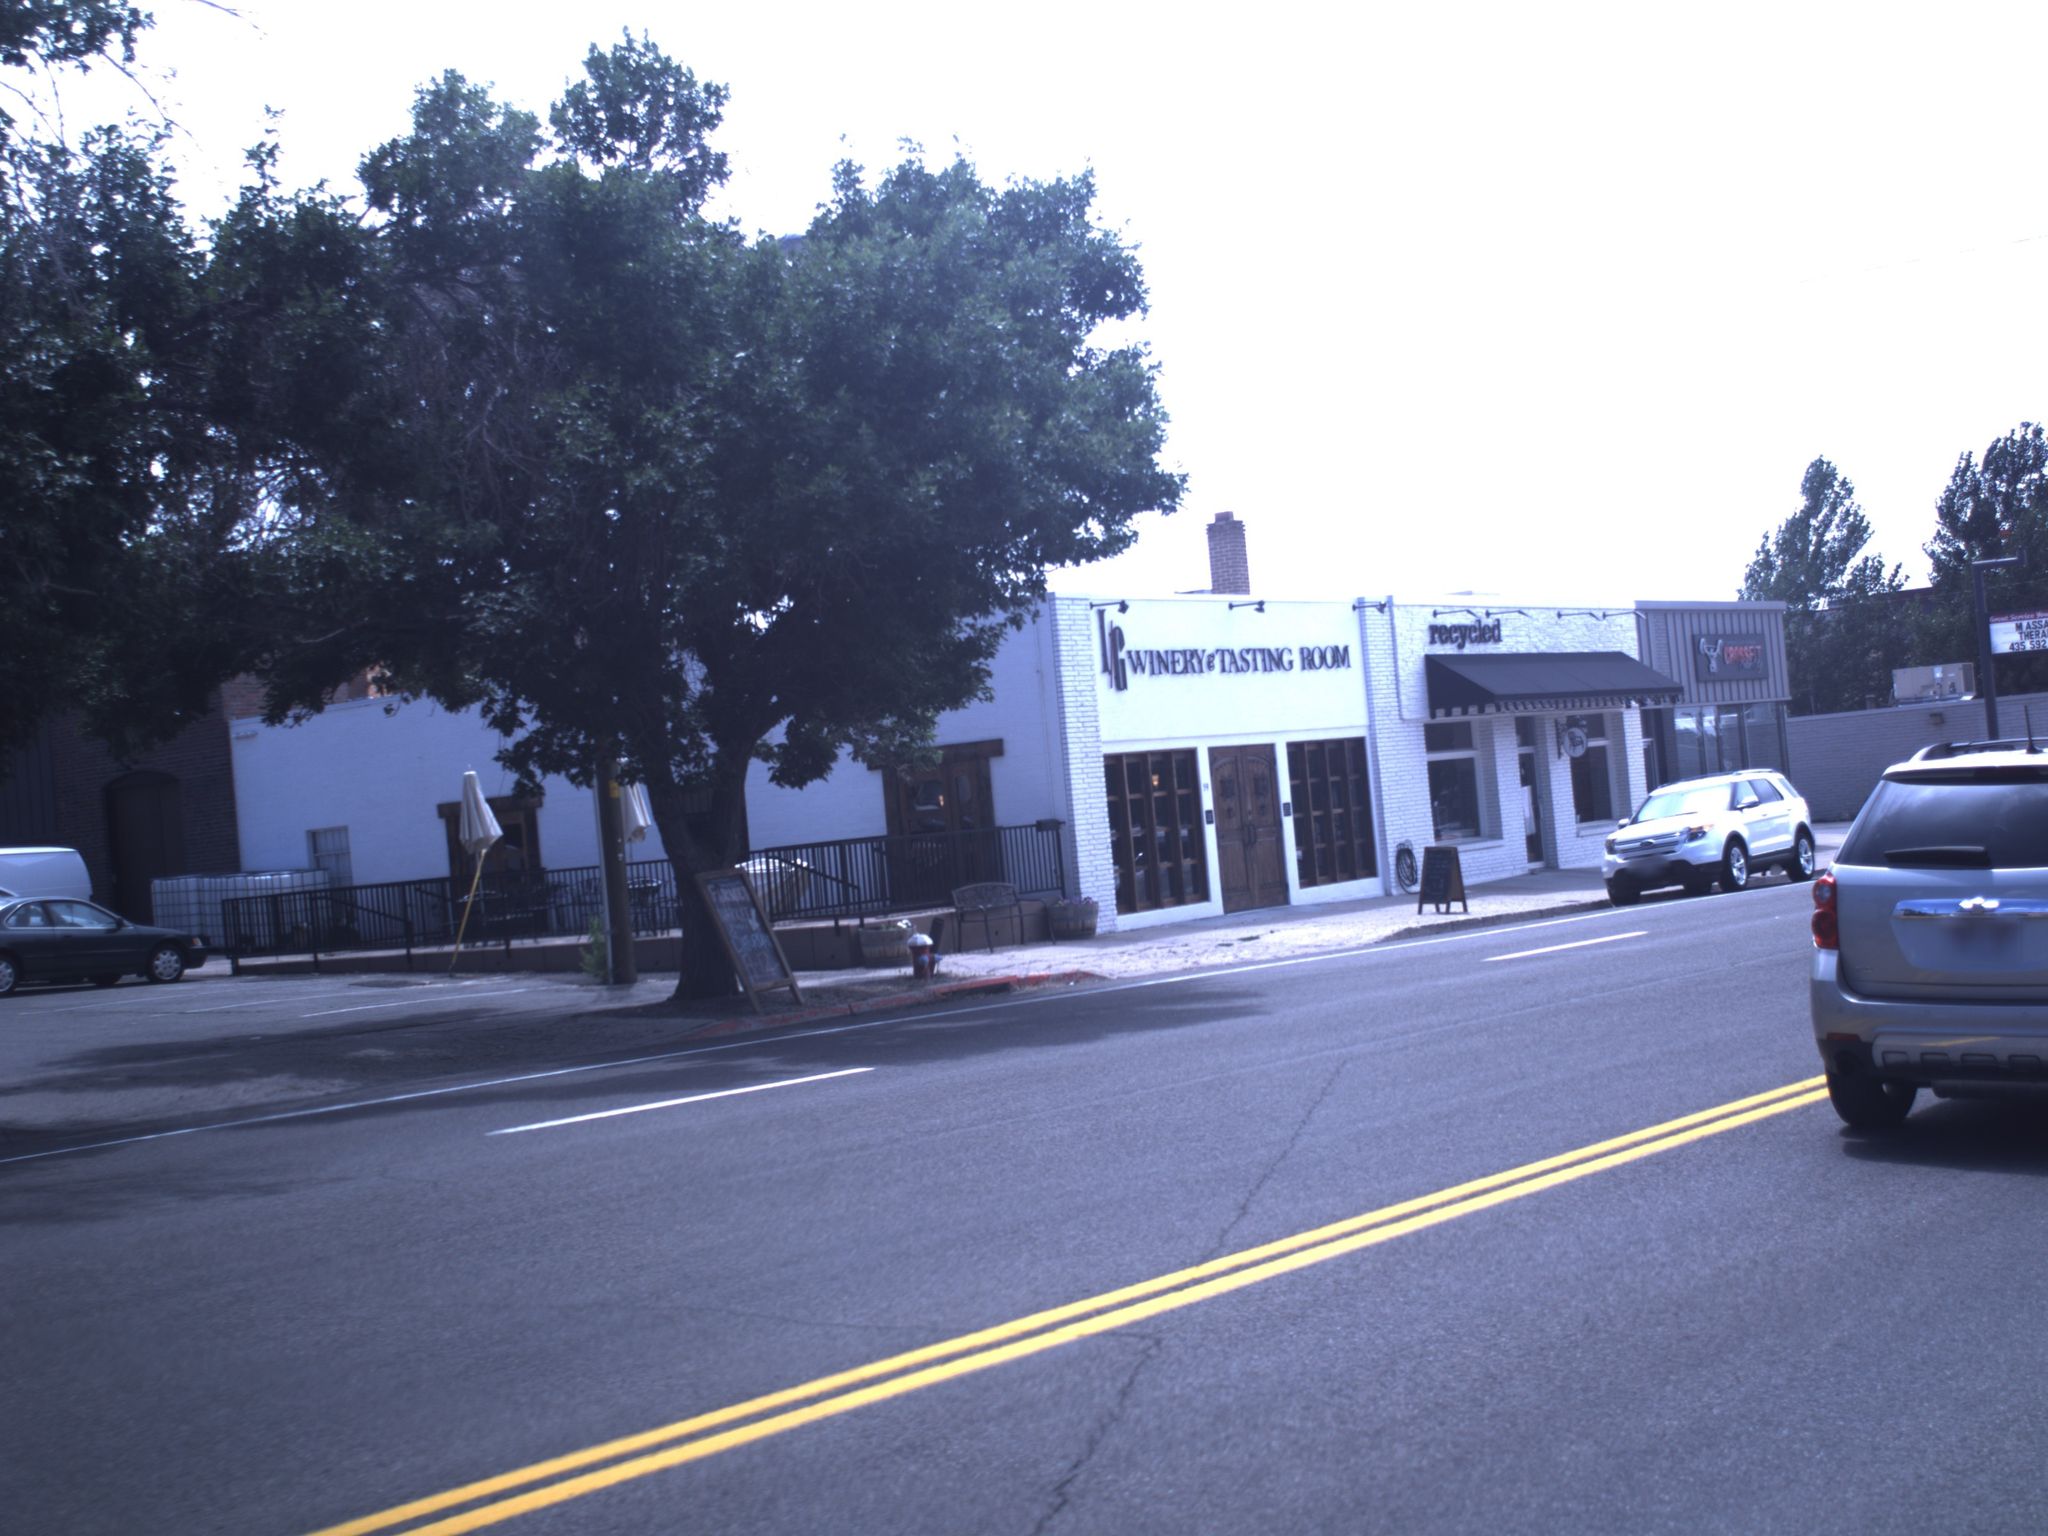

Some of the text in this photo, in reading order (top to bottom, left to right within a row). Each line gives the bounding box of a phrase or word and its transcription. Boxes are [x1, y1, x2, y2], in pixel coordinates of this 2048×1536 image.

[1428, 618, 1504, 650] recycled
[2008, 639, 2047, 651] 435 592
[1127, 649, 1206, 675] WINERY
[1215, 647, 1293, 674] TASTING
[1299, 645, 1351, 671] ROOM
